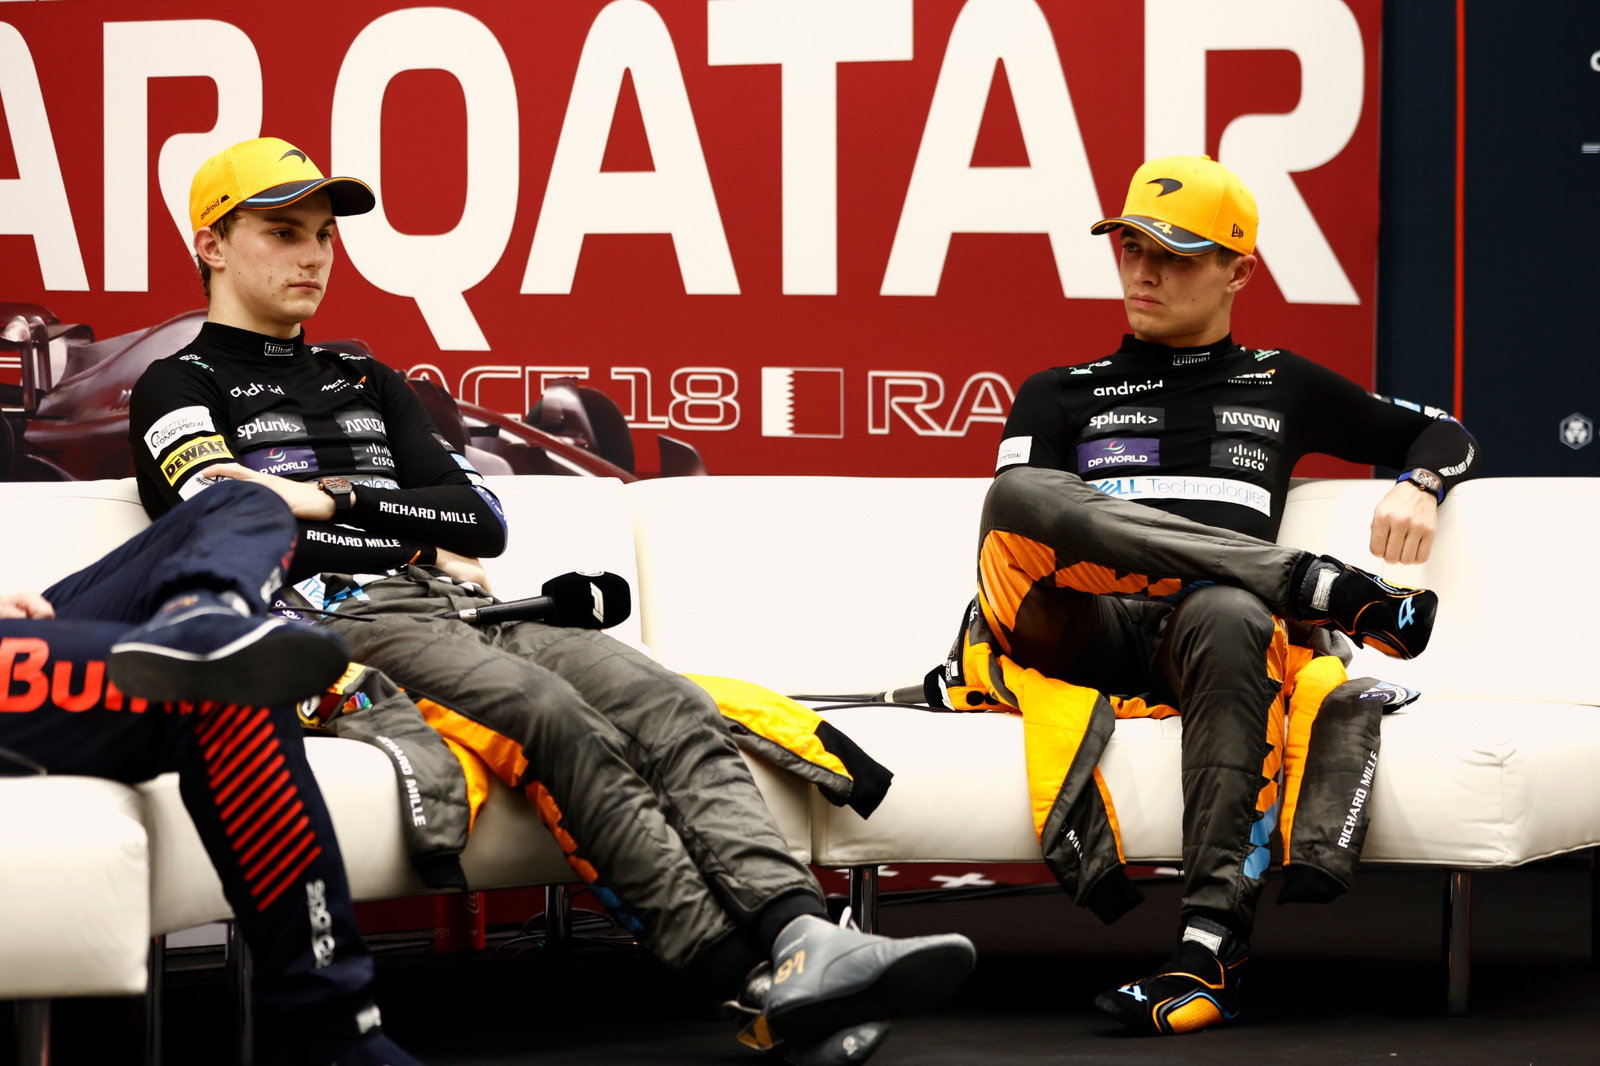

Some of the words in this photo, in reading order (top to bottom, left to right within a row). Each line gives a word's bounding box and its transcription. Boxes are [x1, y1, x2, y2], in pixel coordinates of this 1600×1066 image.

[331, 0, 1361, 352] QATAR
[1152, 221, 1173, 236] 4
[266, 344, 293, 354] Hilton
[611, 366, 741, 431] 18
[1221, 410, 1281, 433] ARROW
[268, 460, 309, 475] WORLD
[1087, 459, 1103, 468] DP
[1104, 454, 1148, 464] WORLD
[1231, 456, 1266, 472] CISCO
[1146, 478, 1267, 507] Technologies
[379, 501, 437, 520] RICHARD
[439, 510, 479, 525] MILLE
[306, 529, 364, 548] RICHARD
[364, 537, 402, 548] MILLE
[0, 636, 149, 713] Bu
[404, 778, 427, 827] MILLE
[1337, 787, 1367, 849] RICHARD
[1359, 750, 1378, 788] MILLE
